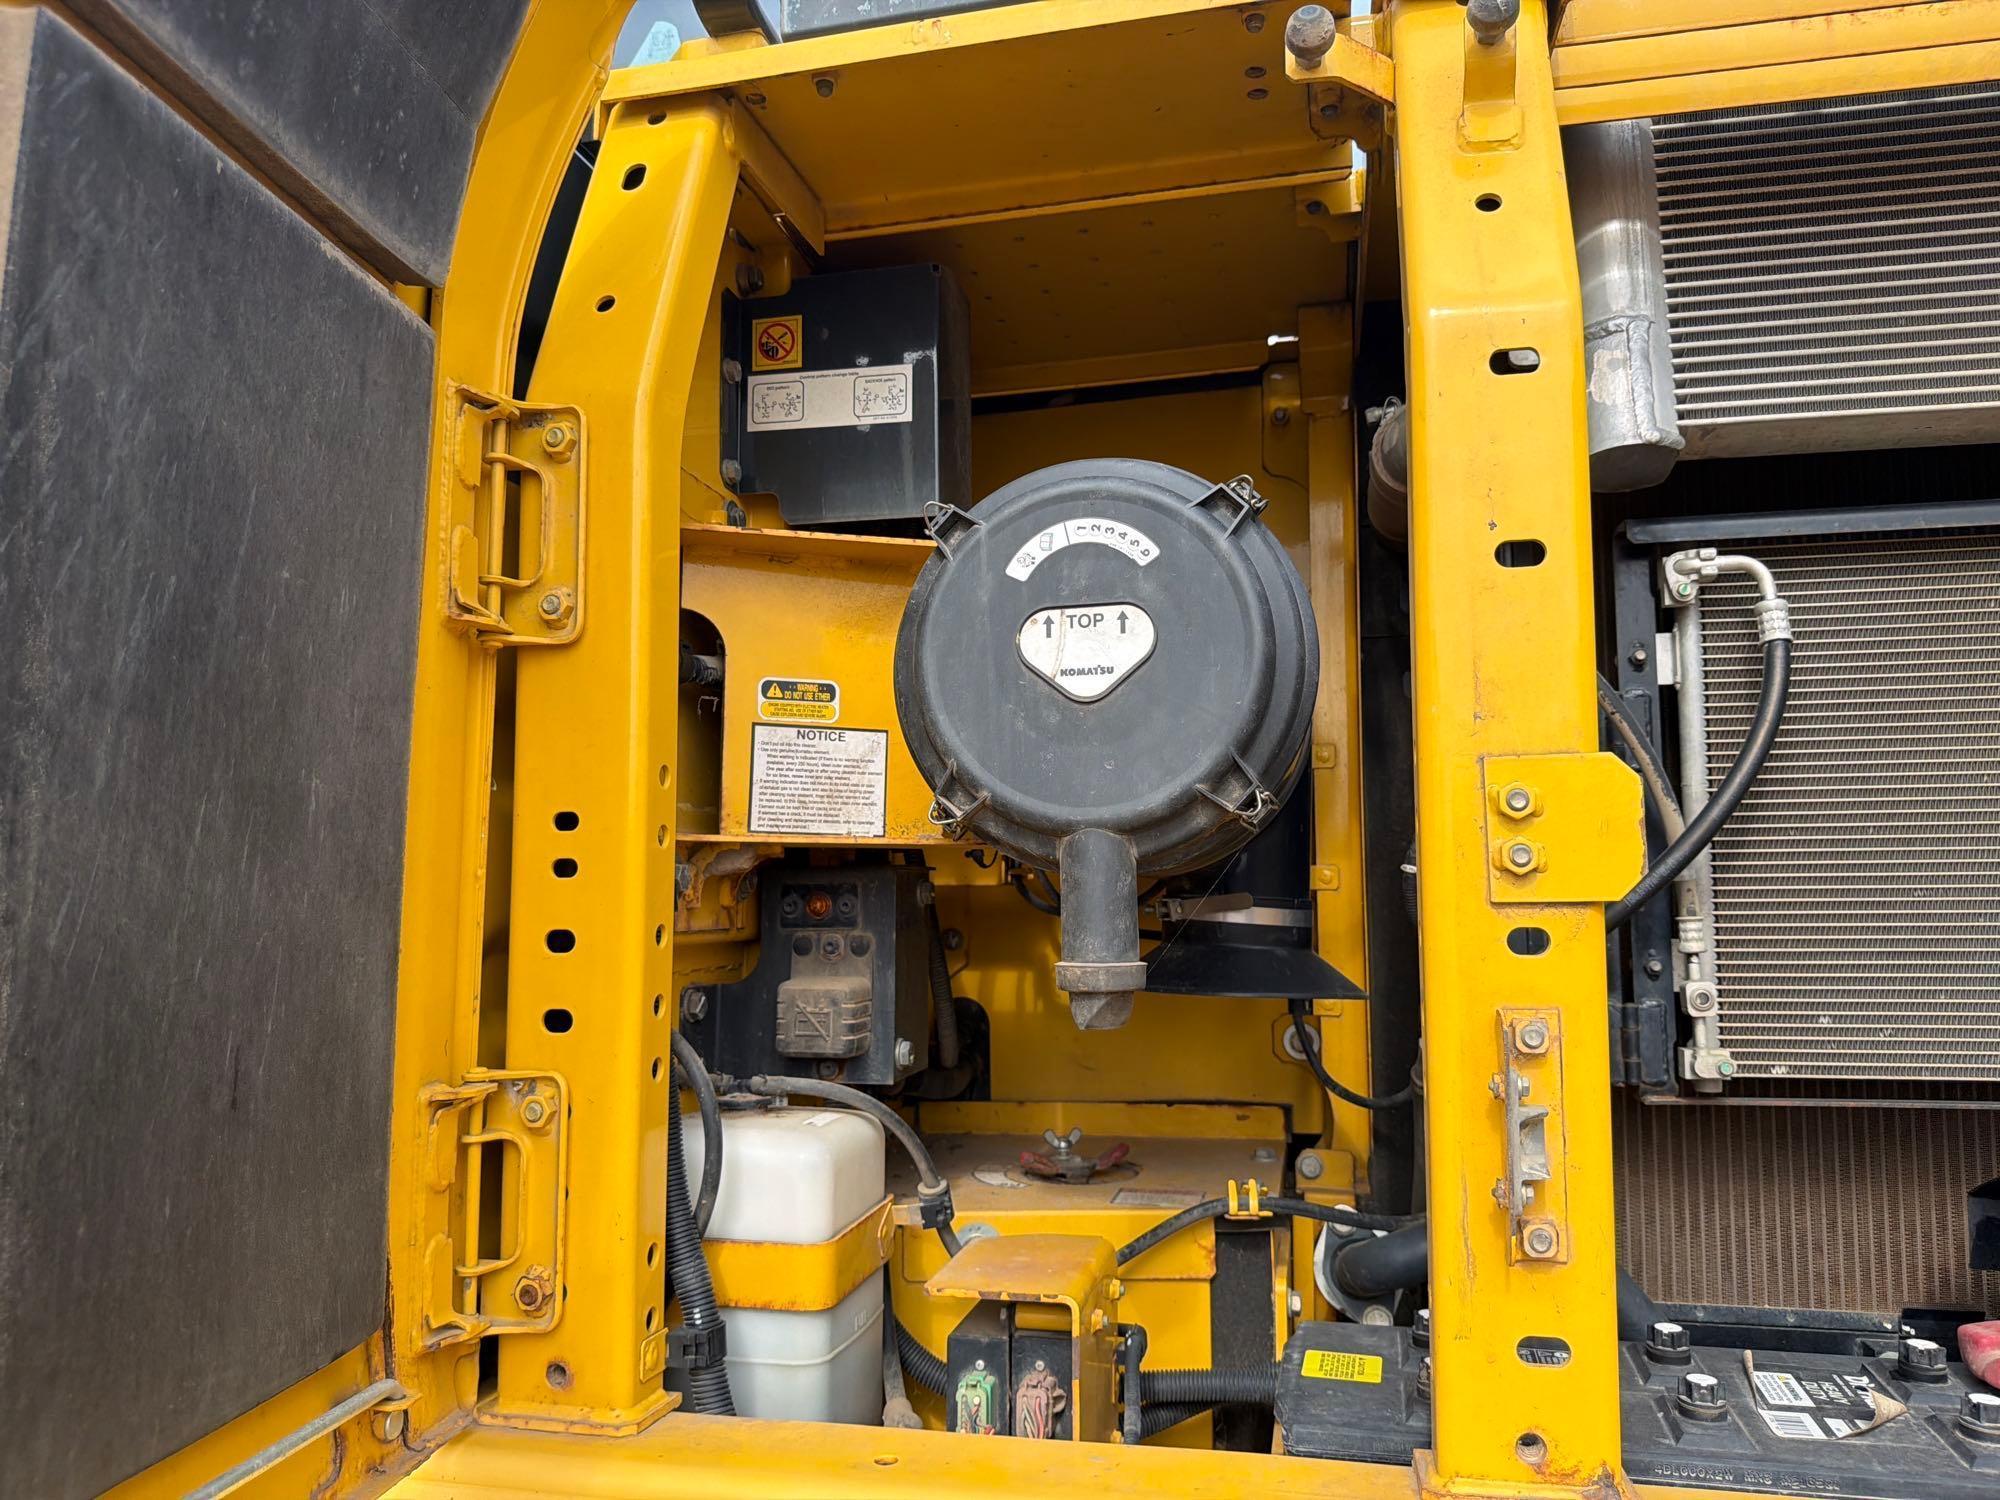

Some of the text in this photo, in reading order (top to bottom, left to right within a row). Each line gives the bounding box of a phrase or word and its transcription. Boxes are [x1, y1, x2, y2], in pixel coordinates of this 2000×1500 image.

[1118, 532, 1128, 540] 4
[1140, 548, 1150, 556] 6
[1067, 613, 1104, 629] TOP
[1060, 665, 1114, 677] KOMATSU
[797, 683, 818, 692] WARNING
[814, 692, 830, 701] ETHER
[797, 730, 846, 742] NOTICE
[1801, 1381, 1830, 1400] DUTY
[1818, 1381, 1851, 1405] HEAVY
